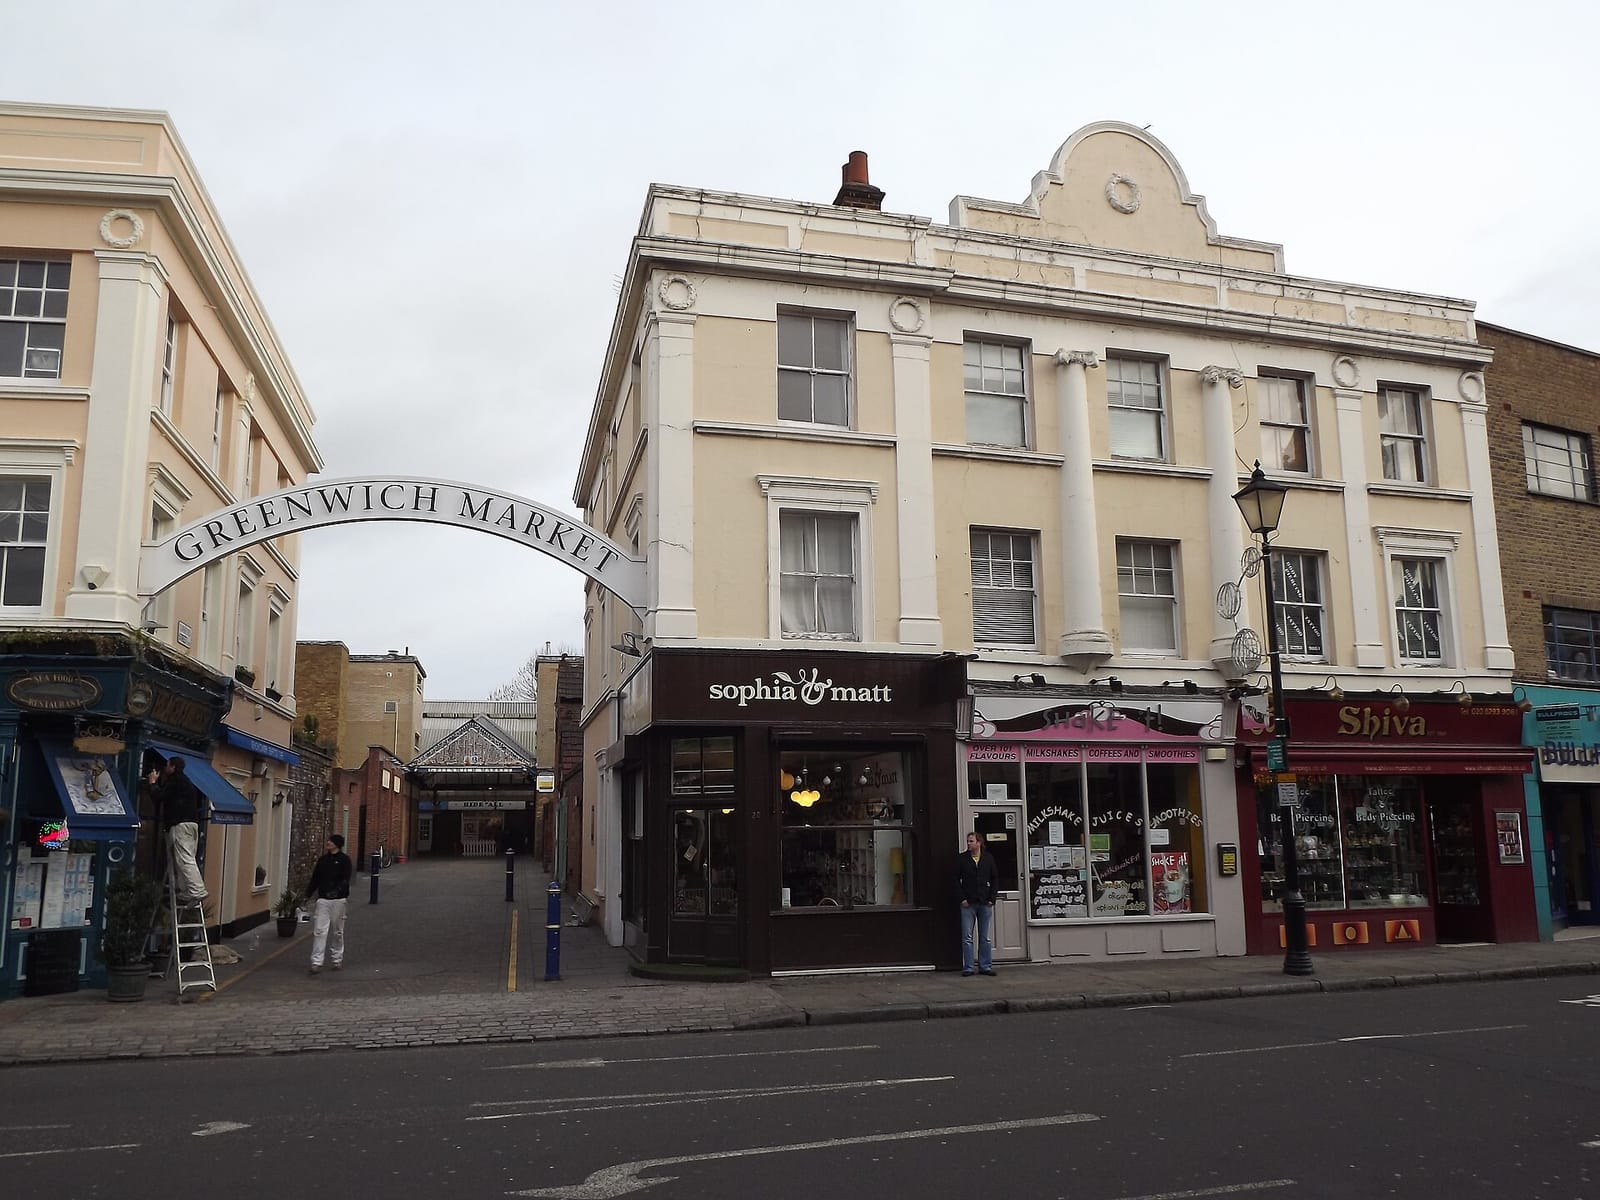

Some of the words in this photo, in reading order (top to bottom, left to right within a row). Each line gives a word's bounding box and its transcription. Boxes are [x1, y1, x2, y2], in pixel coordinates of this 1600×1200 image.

[173, 483, 439, 563] GREENWICH
[457, 491, 621, 574] MARKET
[709, 677, 798, 707] sophia
[799, 667, 833, 706] &
[830, 684, 893, 703] matt
[1337, 705, 1426, 741] Shiva
[969, 752, 1017, 760] FLAVOURS
[1026, 748, 1079, 758] MILKSHAKES
[1088, 748, 1122, 758] COFFEES
[1123, 748, 1139, 758] AND
[1148, 750, 1196, 758] SMOOTHIES
[1027, 805, 1083, 836] MILKSHAKE
[1091, 810, 1145, 827] JUICES
[1150, 807, 1203, 829] SMOOTHIES
